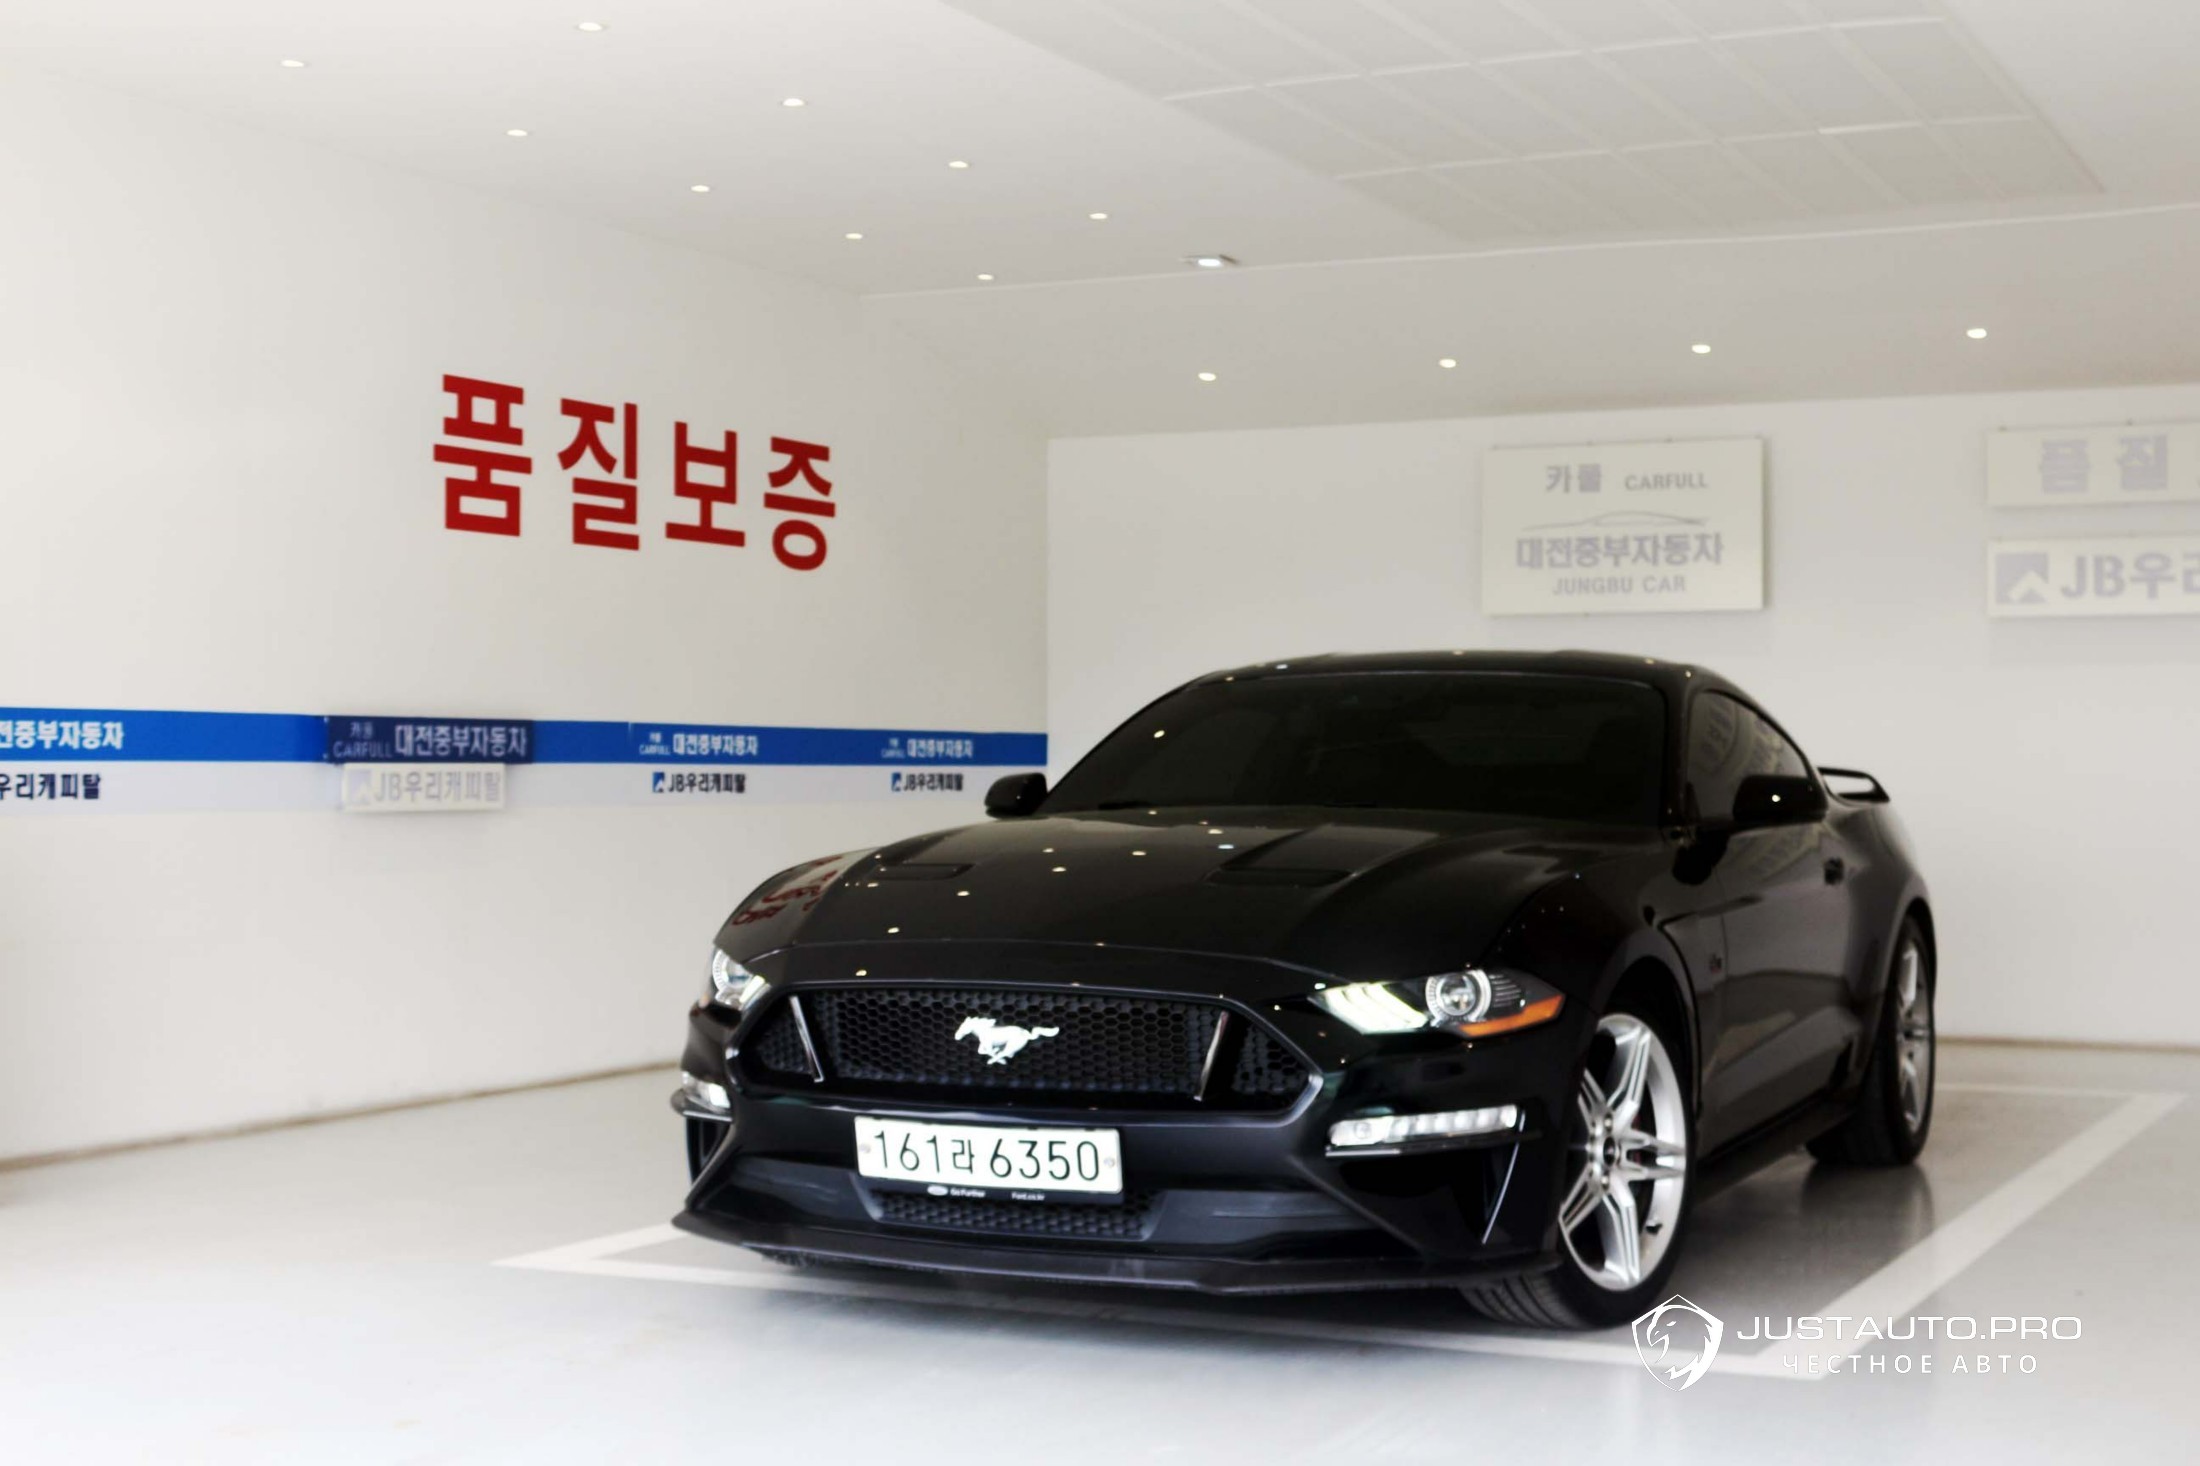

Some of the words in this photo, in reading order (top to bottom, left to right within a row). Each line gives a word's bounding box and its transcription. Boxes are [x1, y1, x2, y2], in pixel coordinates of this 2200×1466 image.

[434, 374, 836, 571] 품질보증
[1624, 472, 1708, 492] CARFULL
[1516, 531, 1723, 569] 대전중부자동차
[1552, 576, 1633, 596] JUNGBU
[1642, 574, 1686, 594] CAR
[333, 741, 392, 758] CARFULL
[395, 724, 526, 757] 대전중부자동차
[874, 1130, 974, 1174] 161라
[989, 1138, 1100, 1181] 6350
